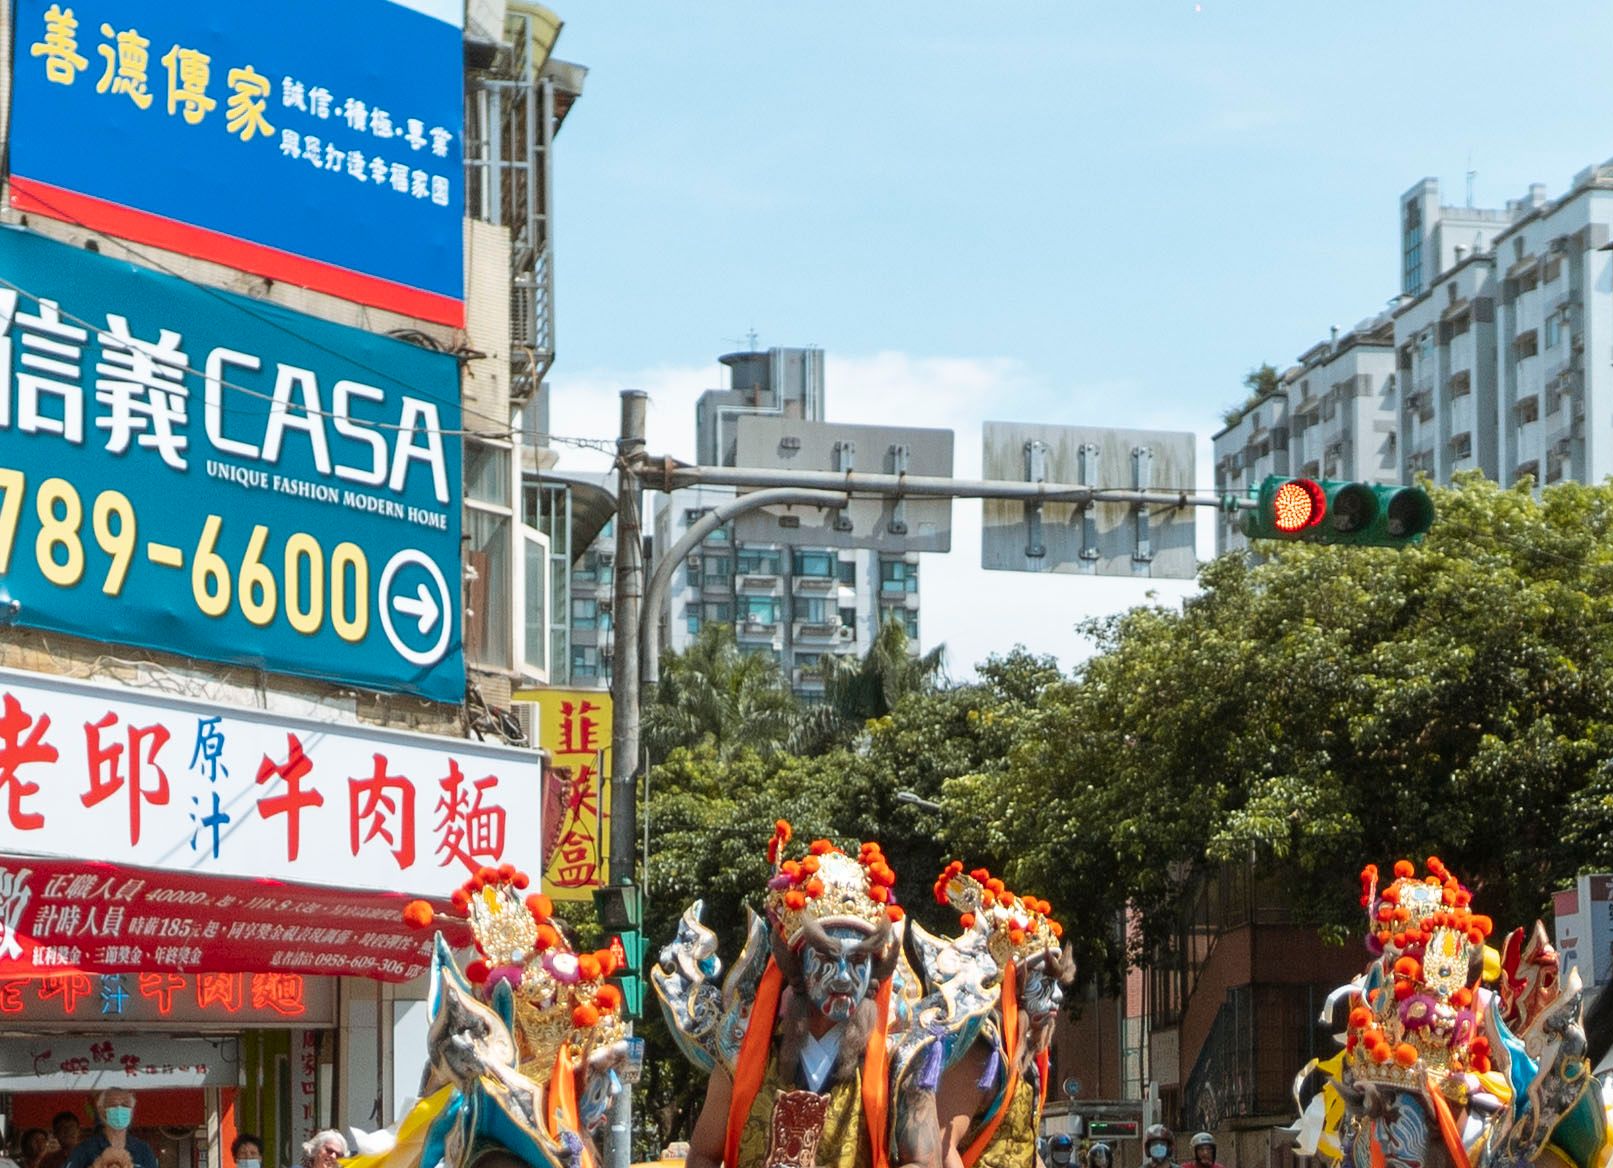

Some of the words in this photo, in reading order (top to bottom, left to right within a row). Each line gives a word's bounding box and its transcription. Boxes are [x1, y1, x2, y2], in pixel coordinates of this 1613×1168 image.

[30, 4, 276, 142] 善德傳家
[206, 459, 269, 488] UNIQUE
[273, 475, 339, 504] FASHION
[343, 490, 404, 520] MODERN
[407, 505, 448, 530] HOME
[188, 714, 231, 861] 原汁
[255, 731, 507, 873] 牛肉麵
[40, 872, 147, 903] 正職人員
[32, 904, 126, 938] 計時人員
[314, 952, 405, 976] 0958-609-306
